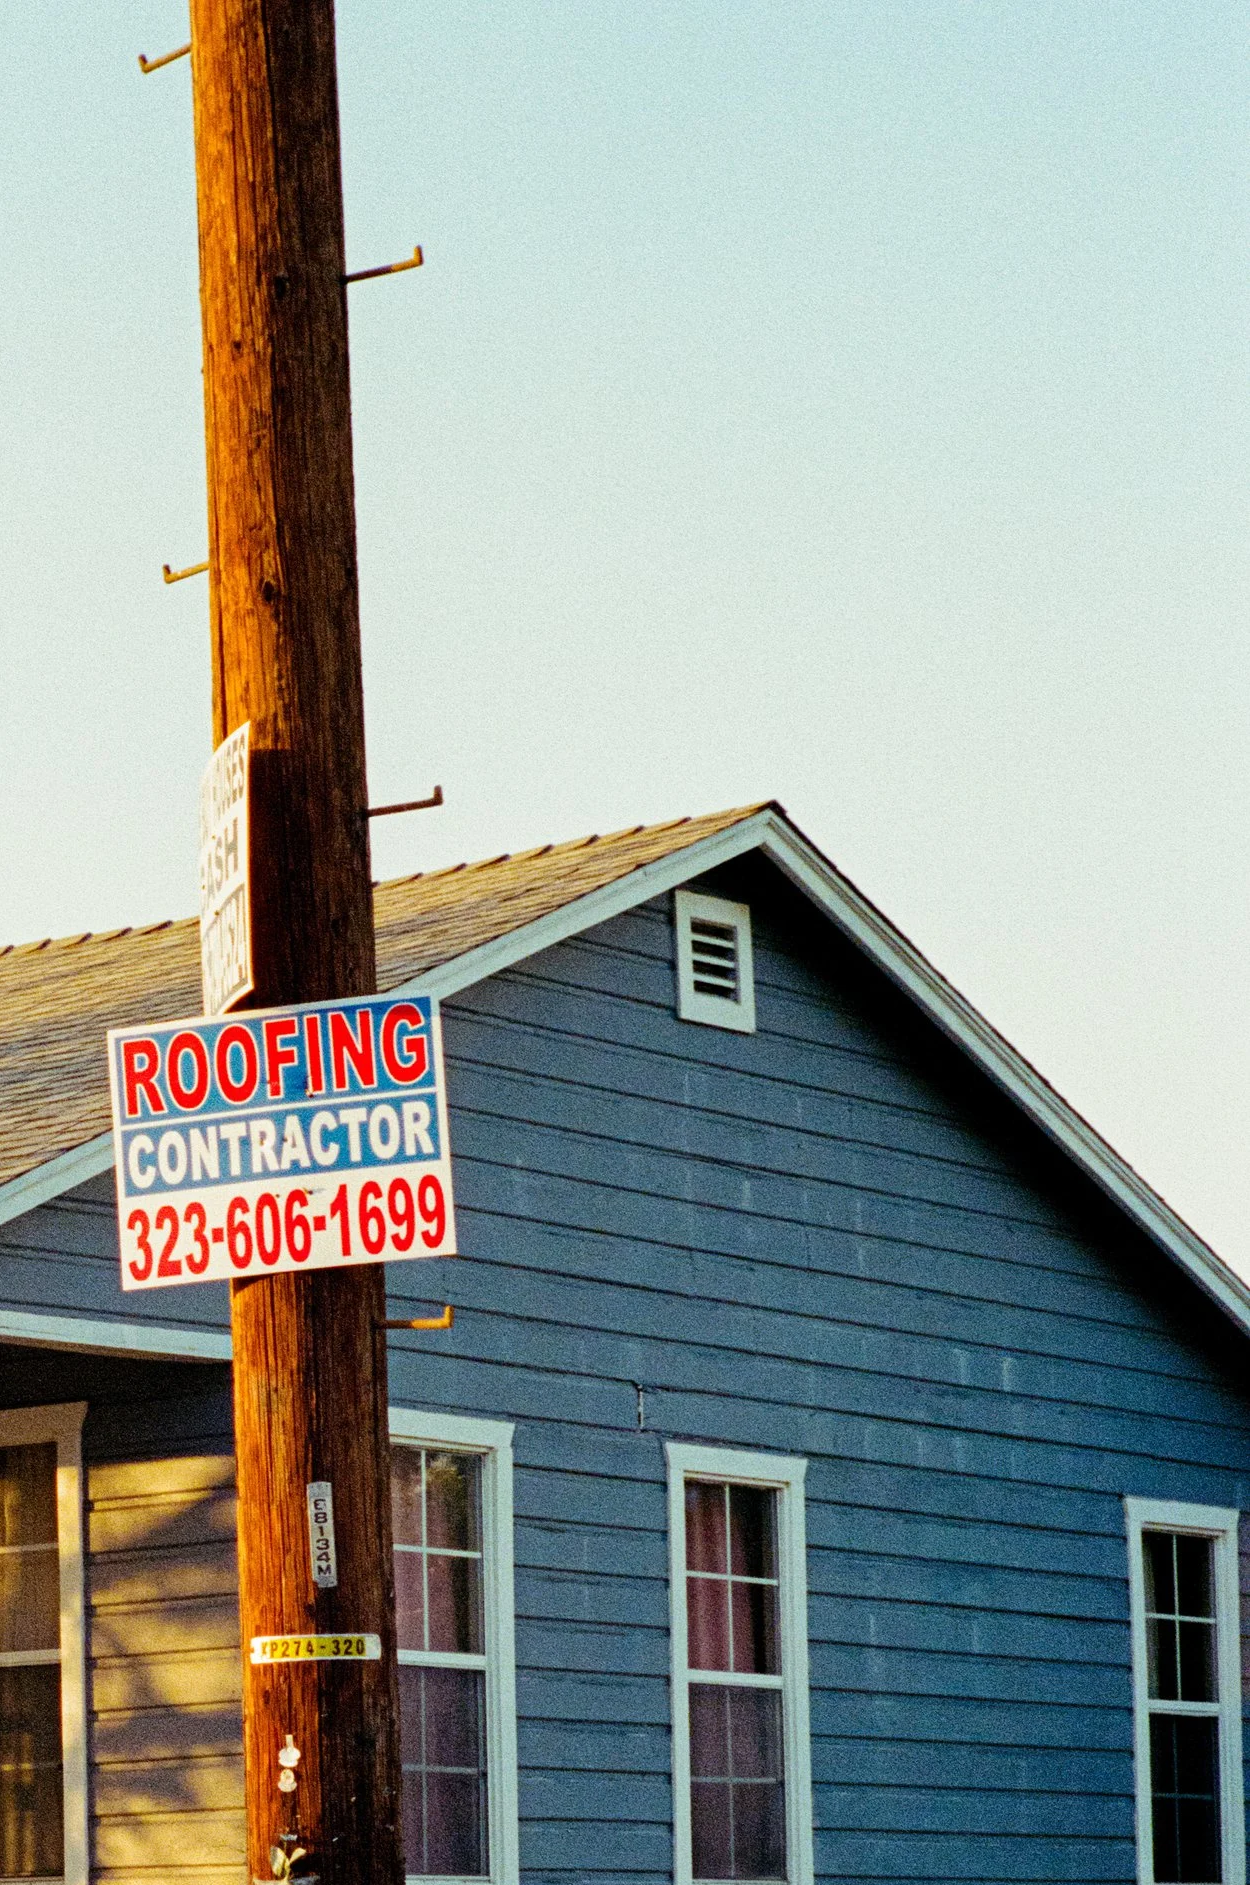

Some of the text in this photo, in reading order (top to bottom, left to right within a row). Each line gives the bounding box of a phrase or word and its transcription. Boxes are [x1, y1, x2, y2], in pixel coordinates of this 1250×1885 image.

[121, 1002, 430, 1117] ROOFING
[128, 1099, 435, 1190] CONTRACTOR
[127, 1174, 446, 1282] 323-606-1699
